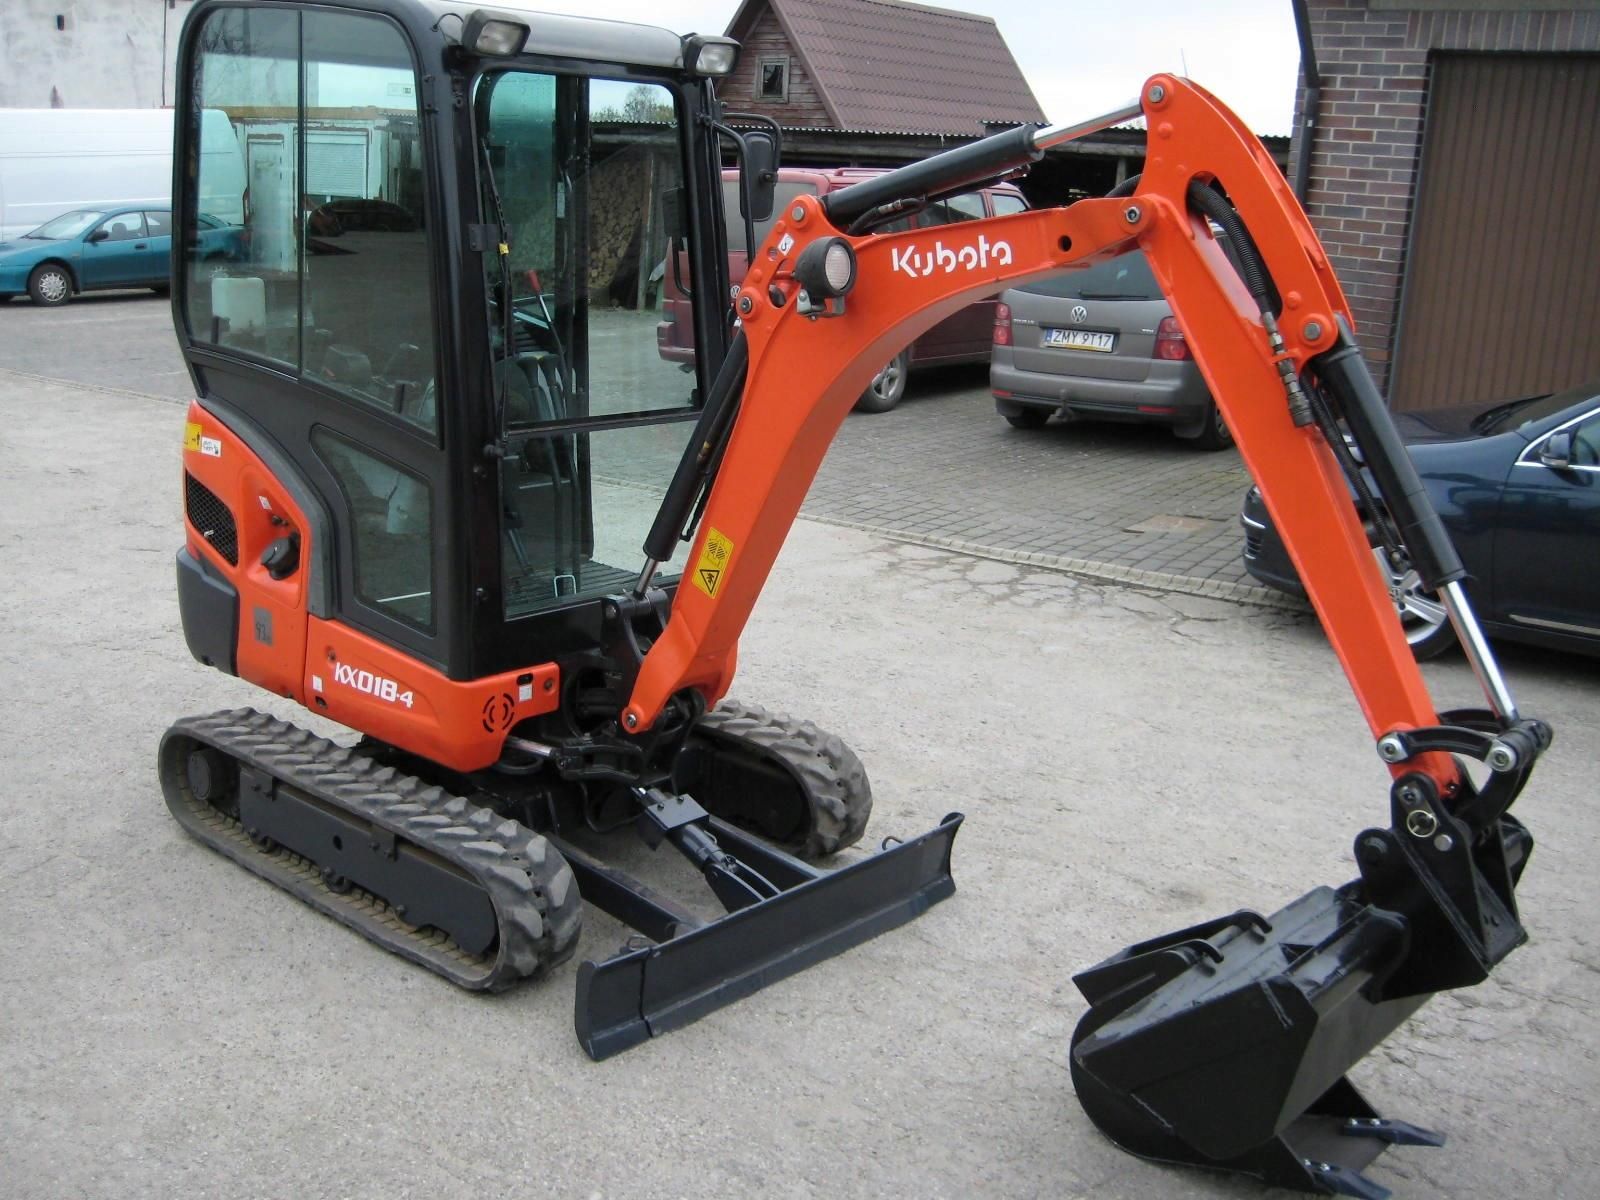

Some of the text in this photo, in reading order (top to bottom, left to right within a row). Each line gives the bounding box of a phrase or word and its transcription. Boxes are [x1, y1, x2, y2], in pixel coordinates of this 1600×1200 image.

[891, 234, 1012, 278] Kubota
[1053, 330, 1111, 348] ZMY 9T17
[334, 661, 414, 709] KX018-4
